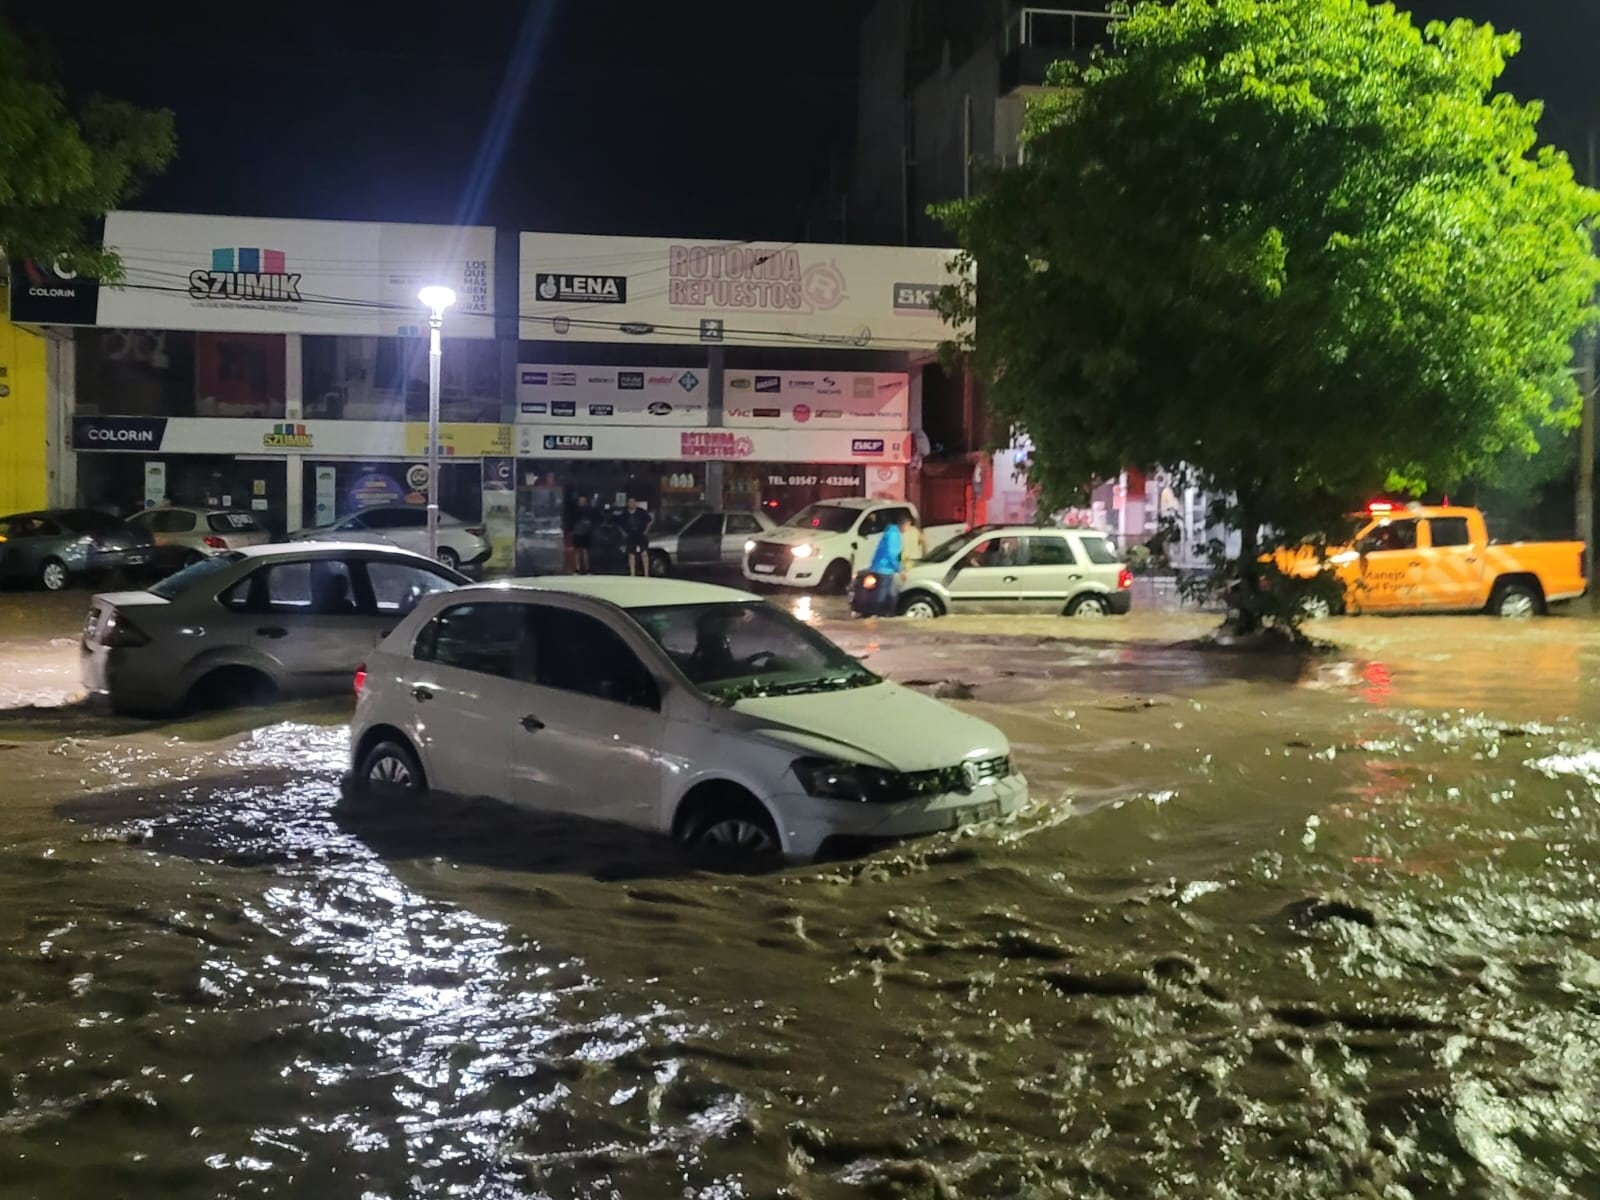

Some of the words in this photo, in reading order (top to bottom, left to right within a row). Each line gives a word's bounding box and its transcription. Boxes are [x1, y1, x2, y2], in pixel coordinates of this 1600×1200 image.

[465, 261, 487, 269] LOS
[669, 245, 801, 281] ROTONDA
[464, 269, 486, 277] QUE
[190, 270, 302, 302] SZUMIK
[560, 276, 618, 294] LENA
[669, 279, 801, 309] REPUESTOS
[556, 436, 589, 446] LENA
